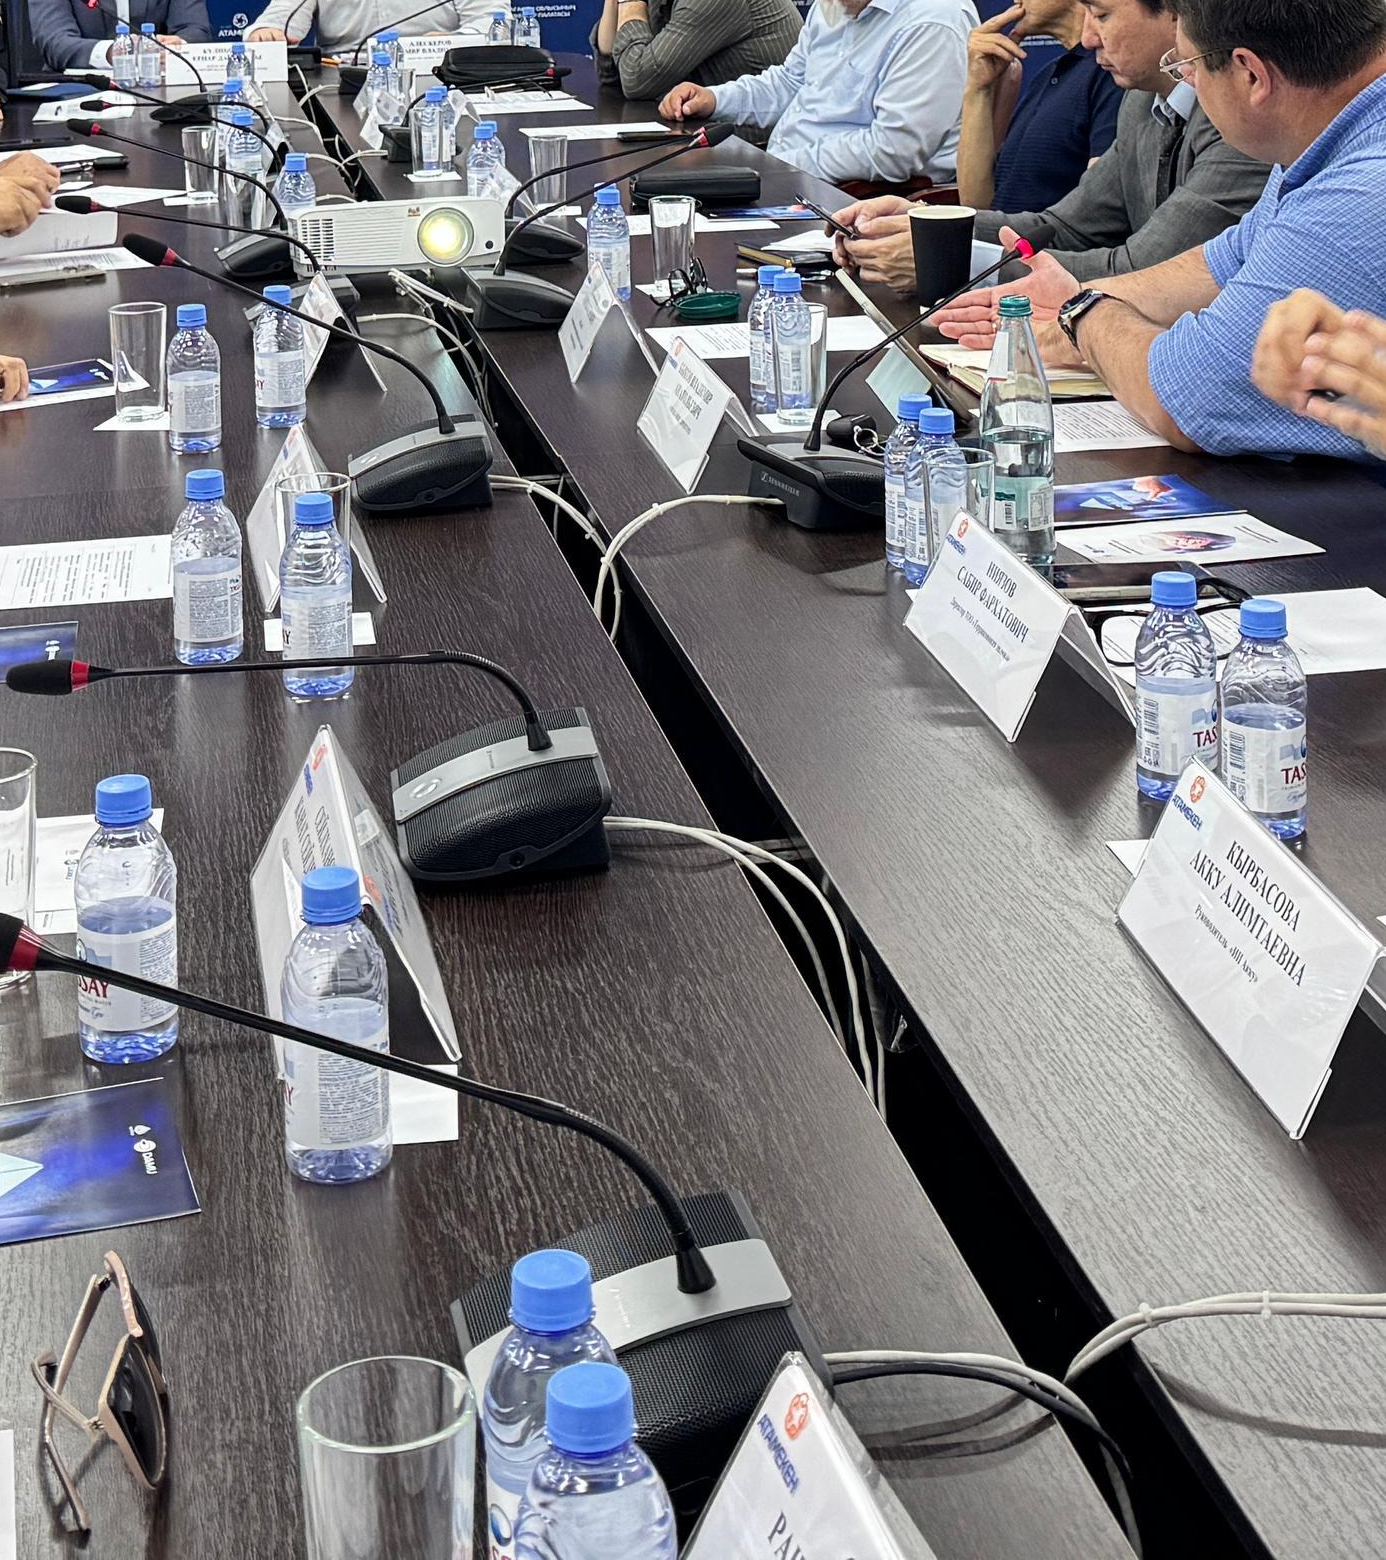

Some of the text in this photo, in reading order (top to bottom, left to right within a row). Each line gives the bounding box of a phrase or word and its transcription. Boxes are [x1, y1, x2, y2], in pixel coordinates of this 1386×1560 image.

[957, 566, 982, 596] САБИР
[979, 588, 1029, 643] ФАРХАТОВИЧ
[1172, 793, 1203, 832] АТАМЕКЕН
[1190, 849, 1307, 987] АККУ АЛИМТАЕВНА
[1226, 840, 1302, 932] КЫРБАСОВА
[142, 1151, 158, 1175] DAMU
[757, 1413, 801, 1496] АТАМЕКЕН
